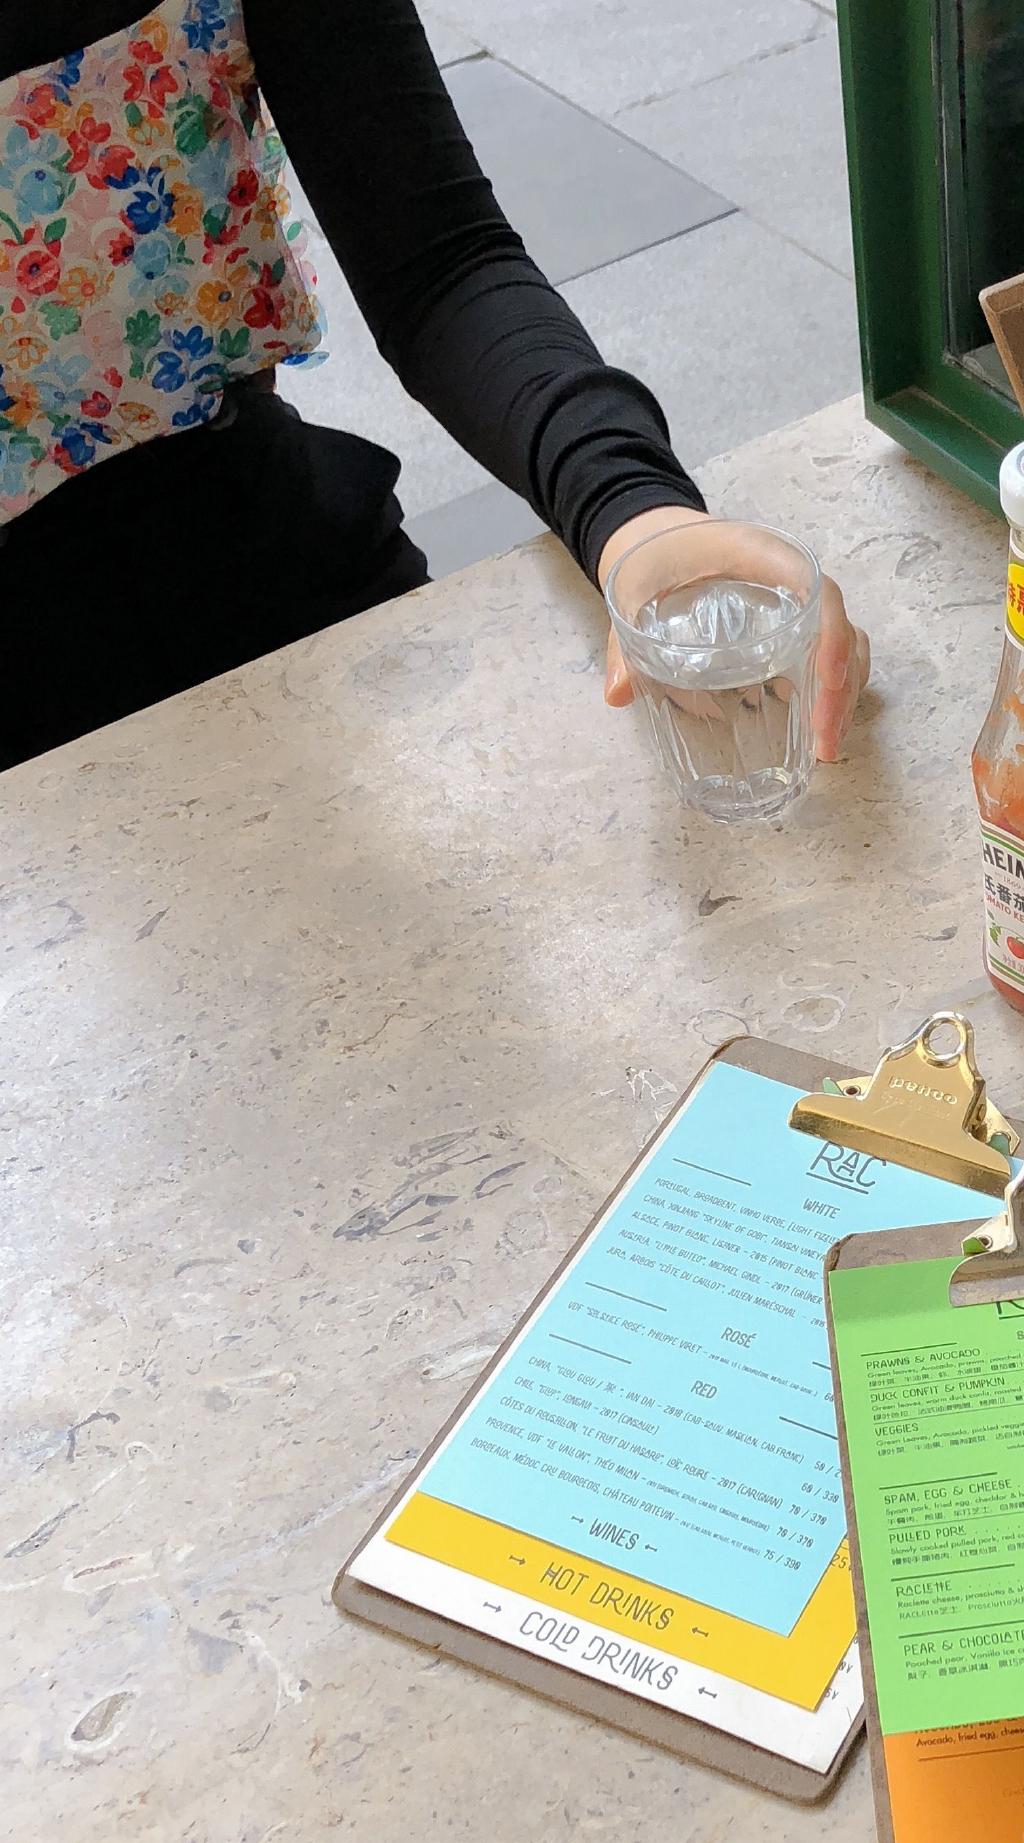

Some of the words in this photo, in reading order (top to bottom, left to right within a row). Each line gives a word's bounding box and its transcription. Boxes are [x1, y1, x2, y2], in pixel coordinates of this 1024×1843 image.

[889, 1076, 957, 1105] penco
[808, 1139, 890, 1189] RAC
[738, 1206, 762, 1219] VINHO
[800, 1197, 841, 1219] WHITE
[733, 1224, 747, 1234] OF
[661, 1220, 685, 1234] PINOT
[793, 1265, 820, 1280] BLANC
[707, 1259, 741, 1276] MICHAEL
[679, 1270, 693, 1281] DU
[726, 1287, 754, 1302] JULIEN
[566, 1300, 584, 1312] VDF
[646, 1328, 679, 1346] PHILIPPE
[676, 1339, 703, 1354] VIRET
[719, 1324, 758, 1348] ROSÉ
[865, 1356, 910, 1370] PRAWNS
[913, 1354, 926, 1363] &
[928, 1347, 981, 1362] AVOCADO
[639, 1395, 656, 1408] DAI
[688, 1379, 719, 1400] RED
[869, 1390, 897, 1403] DUCK
[901, 1385, 939, 1398] CONFIT
[943, 1383, 955, 1393] &
[958, 1376, 1005, 1391] PUMPKIN
[498, 1395, 525, 1411] CÔTES
[522, 1404, 537, 1415] DU
[593, 1430, 618, 1446] FRUIT
[616, 1438, 631, 1450] DU
[873, 1422, 919, 1437] VEGGIES
[525, 1431, 544, 1444] VDF
[593, 1456, 617, 1471] THÉO
[613, 1464, 641, 1481] MILAN
[883, 1491, 920, 1505] SPAM,
[923, 1487, 947, 1500] EGG
[951, 1484, 964, 1496] &
[967, 1478, 1013, 1494] CHEESE
[511, 1452, 541, 1469] MÉDOC
[538, 1462, 559, 1477] CRU
[601, 1486, 640, 1507] CHÂTEAU
[637, 1500, 675, 1521] POITEVIN
[761, 1548, 776, 1561] 75
[585, 1517, 642, 1551] WINES
[888, 1529, 931, 1544] PULLED
[935, 1524, 967, 1539] PORK
[949, 1538, 976, 1548] pulled
[540, 1561, 589, 1596] HOT
[589, 1582, 675, 1631] DRINKS
[519, 1611, 580, 1652] COLD
[581, 1635, 679, 1691] DRINKS
[902, 1641, 936, 1657] PEAR
[940, 1639, 954, 1651] &
[915, 1735, 954, 1747] Avocado,
[958, 1731, 978, 1743] fried
